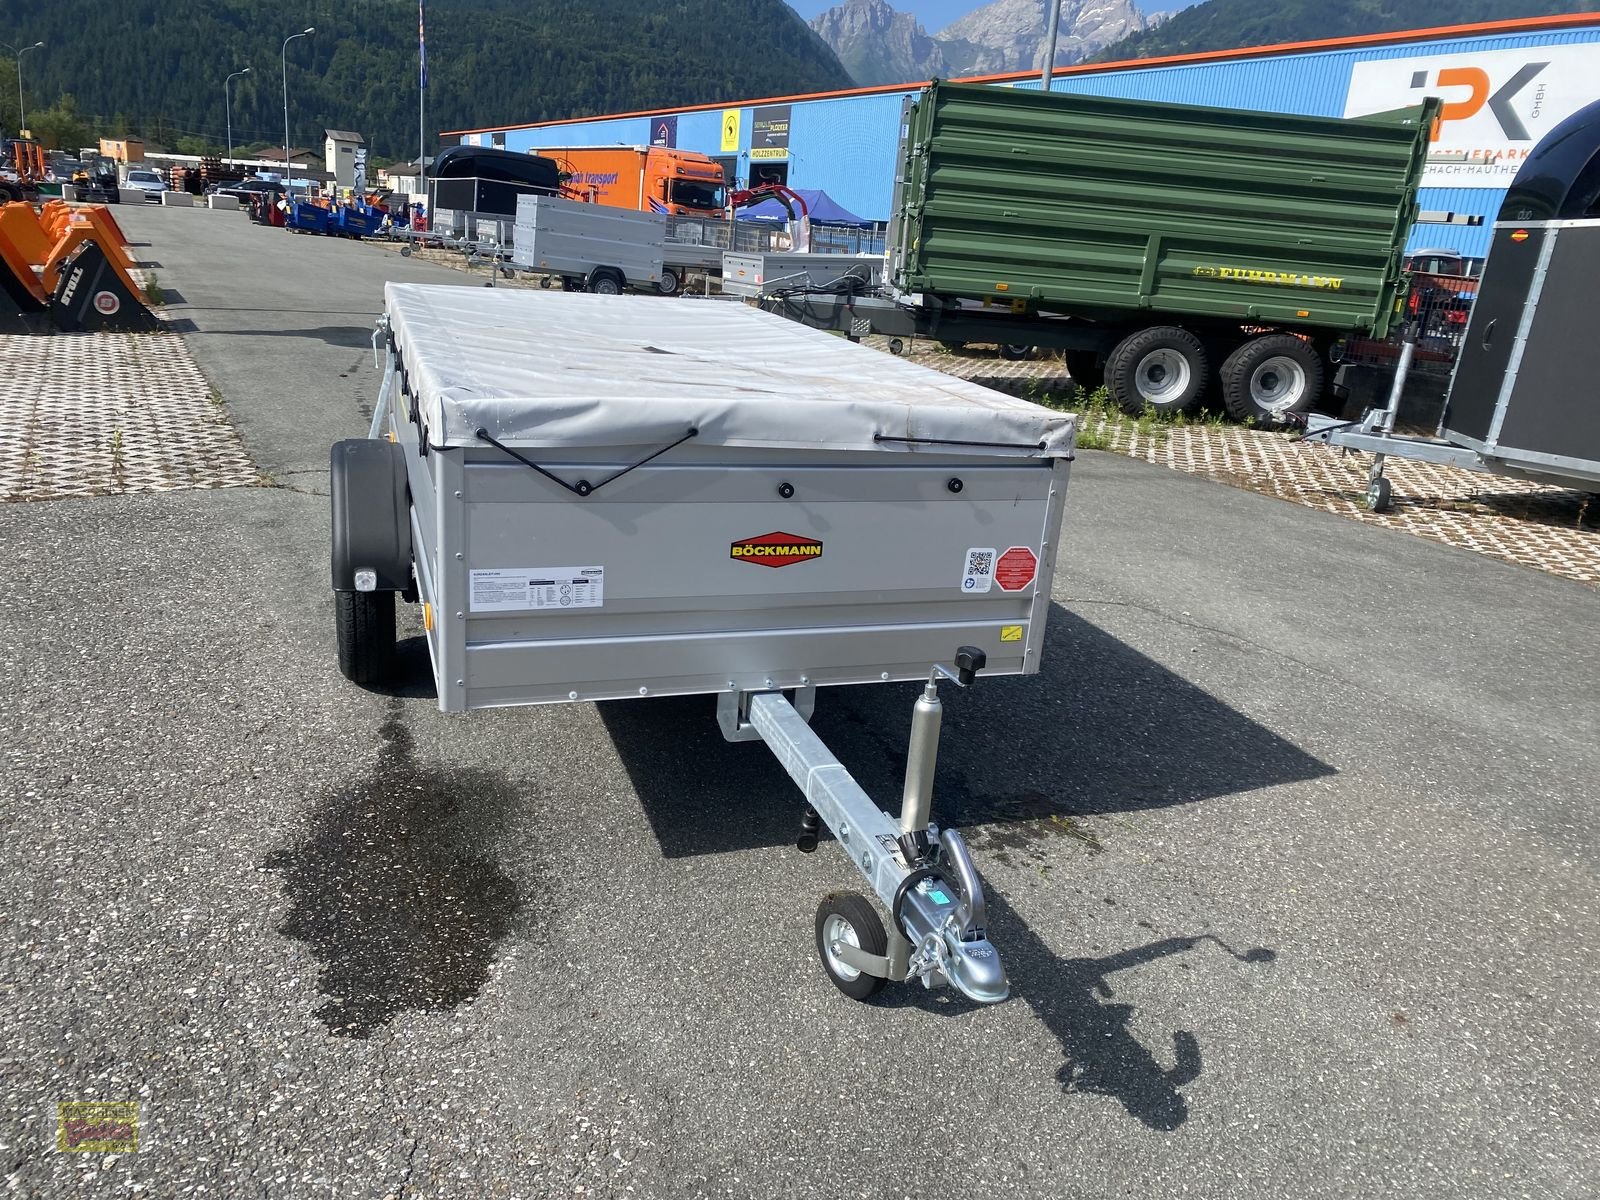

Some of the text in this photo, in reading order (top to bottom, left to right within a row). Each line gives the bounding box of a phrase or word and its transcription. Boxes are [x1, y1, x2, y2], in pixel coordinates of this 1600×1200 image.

[585, 171, 619, 188] transport
[60, 266, 84, 306] STOLL
[1218, 266, 1343, 289] FUHRMANN
[731, 544, 822, 557] BÖCKMANN
